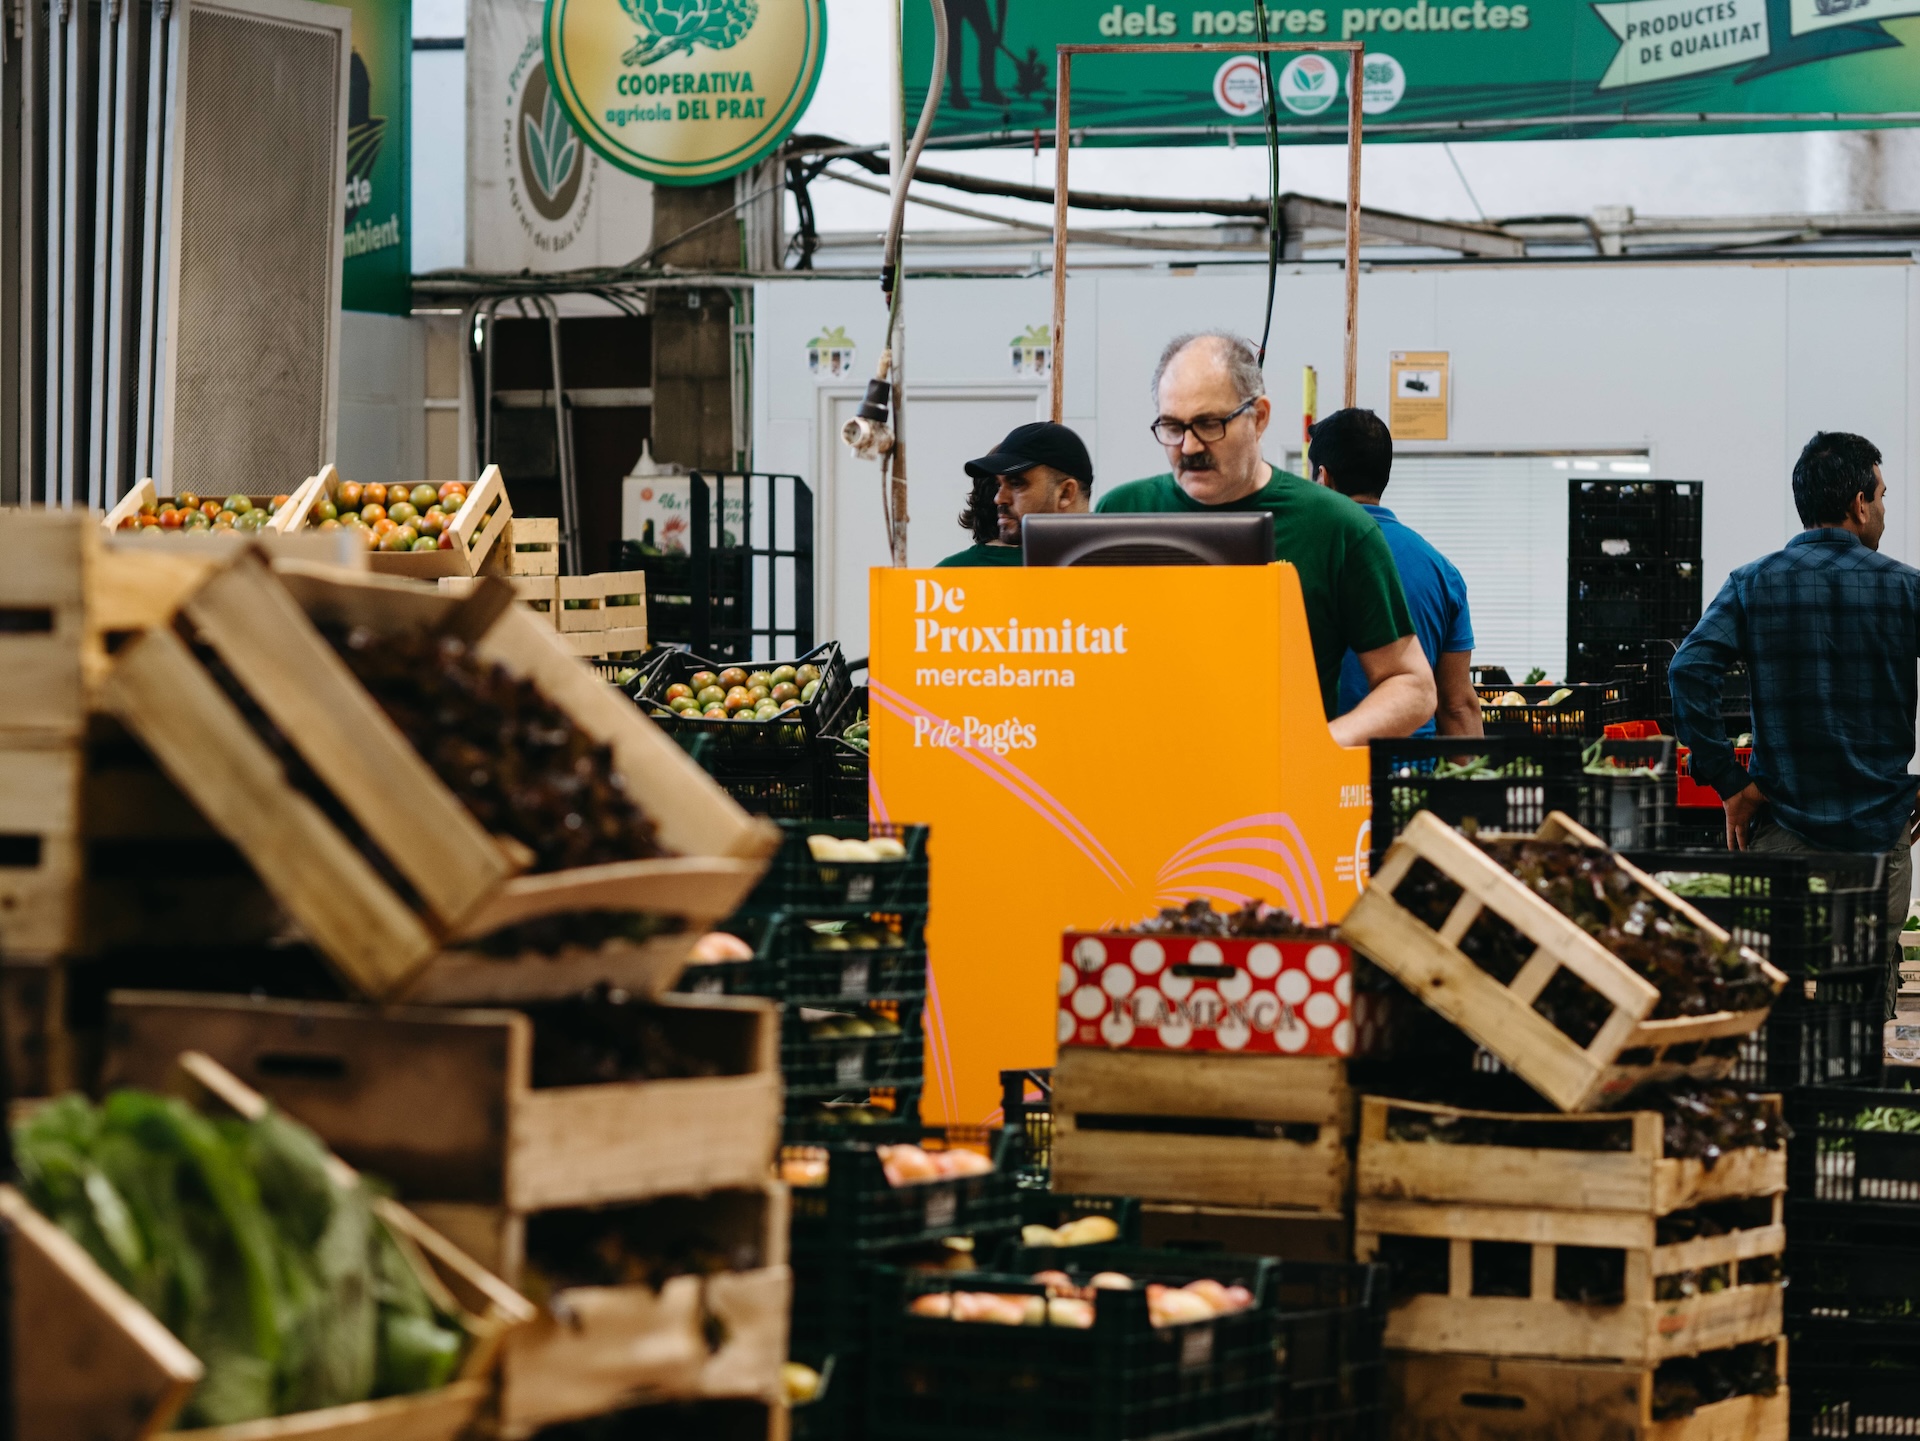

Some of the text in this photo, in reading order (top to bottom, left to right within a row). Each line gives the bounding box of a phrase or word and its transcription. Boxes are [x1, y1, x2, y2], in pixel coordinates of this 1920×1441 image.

[1098, 4, 1177, 37] dels
[1341, 0, 1530, 40] productes
[1626, 1, 1738, 41] PRODUCTES
[1640, 22, 1762, 65] DE QUALITAT
[617, 71, 754, 96] COOPERATIVA
[677, 99, 710, 121] DEL
[716, 97, 766, 120] PRAT
[345, 174, 372, 209] cte
[344, 213, 400, 259] mbient
[914, 579, 966, 613] De
[914, 617, 1128, 654] Proximitat
[916, 663, 1075, 687] mercabarna
